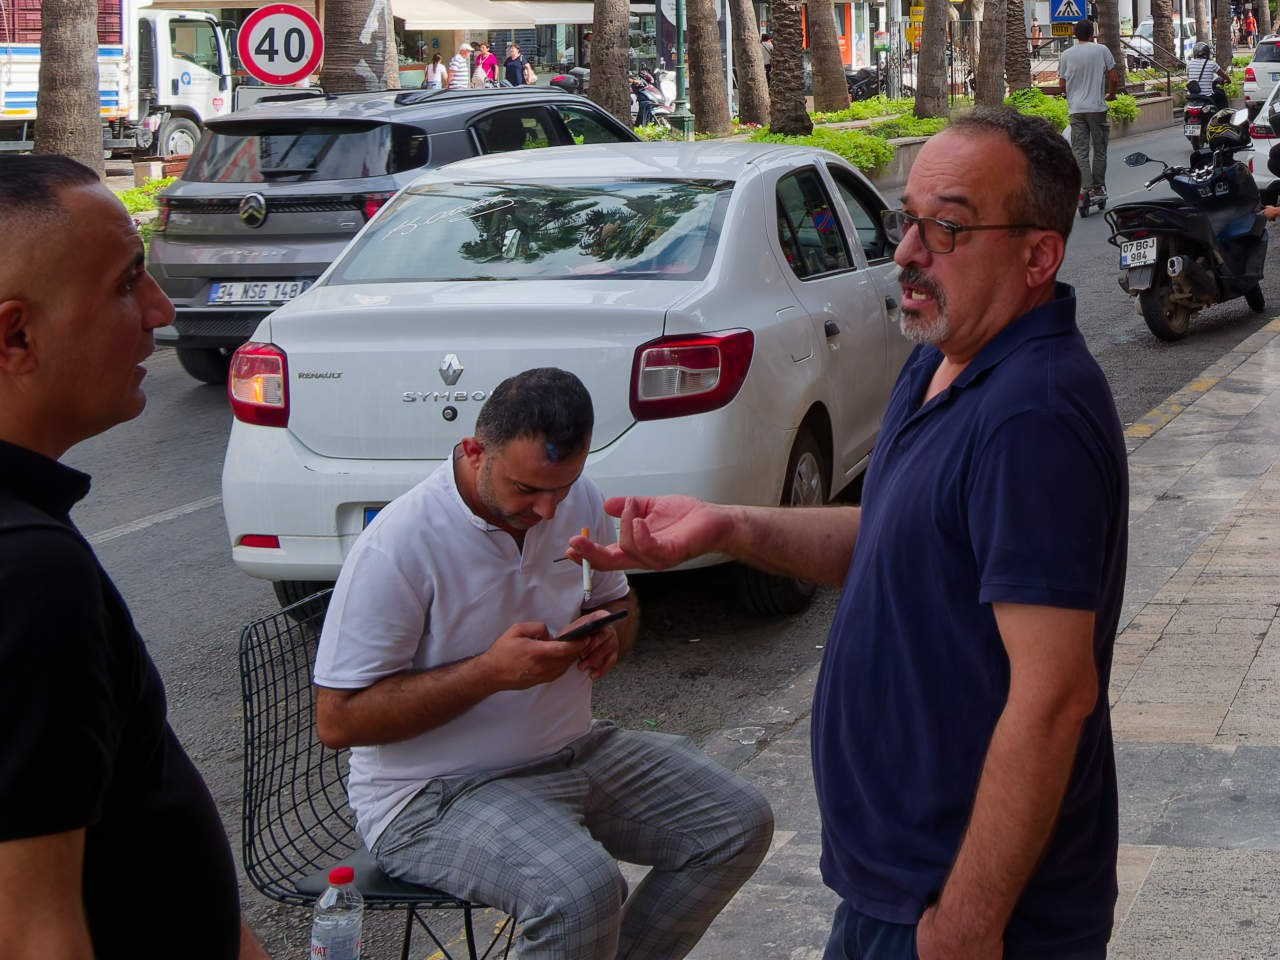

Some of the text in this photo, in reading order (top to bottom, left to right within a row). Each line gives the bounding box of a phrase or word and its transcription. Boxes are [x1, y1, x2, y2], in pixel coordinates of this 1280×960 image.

[254, 27, 306, 64] 40
[1123, 243, 1135, 254] 07
[1130, 251, 1148, 262] 984
[218, 284, 234, 300] 34
[298, 372, 344, 380] RENAULT
